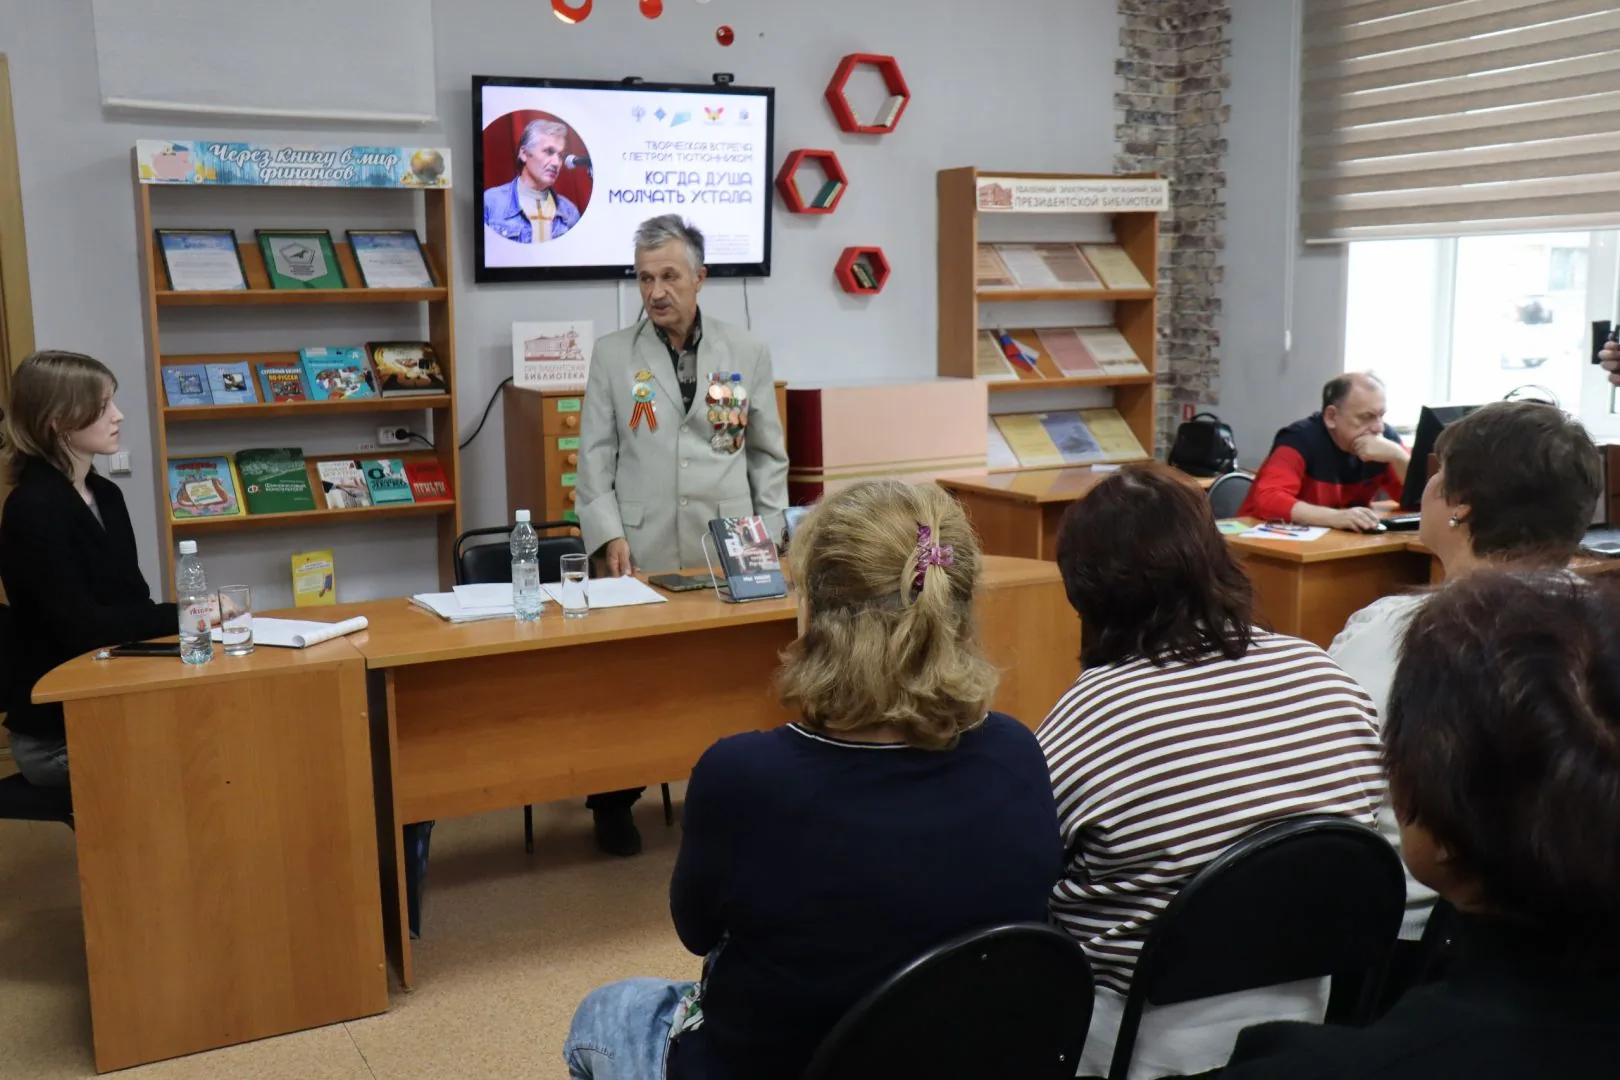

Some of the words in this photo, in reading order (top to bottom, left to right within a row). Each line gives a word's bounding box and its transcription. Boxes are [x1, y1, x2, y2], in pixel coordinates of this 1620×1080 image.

[209, 143, 272, 167] Через
[341, 147, 353, 164] в
[356, 153, 399, 170] мир
[259, 165, 354, 183] финансов
[645, 170, 700, 186] КОГДА
[705, 171, 752, 186] ДУША
[609, 189, 685, 204] МОЛЧАТЬ
[691, 190, 752, 204] УСТАЛА
[1015, 195, 1098, 208] ПРЕЗИДЕНТСКОЙ
[1102, 196, 1163, 208] БИБЛИОТЕКИ
[524, 372, 585, 381] БИБЛИОТЕКА
